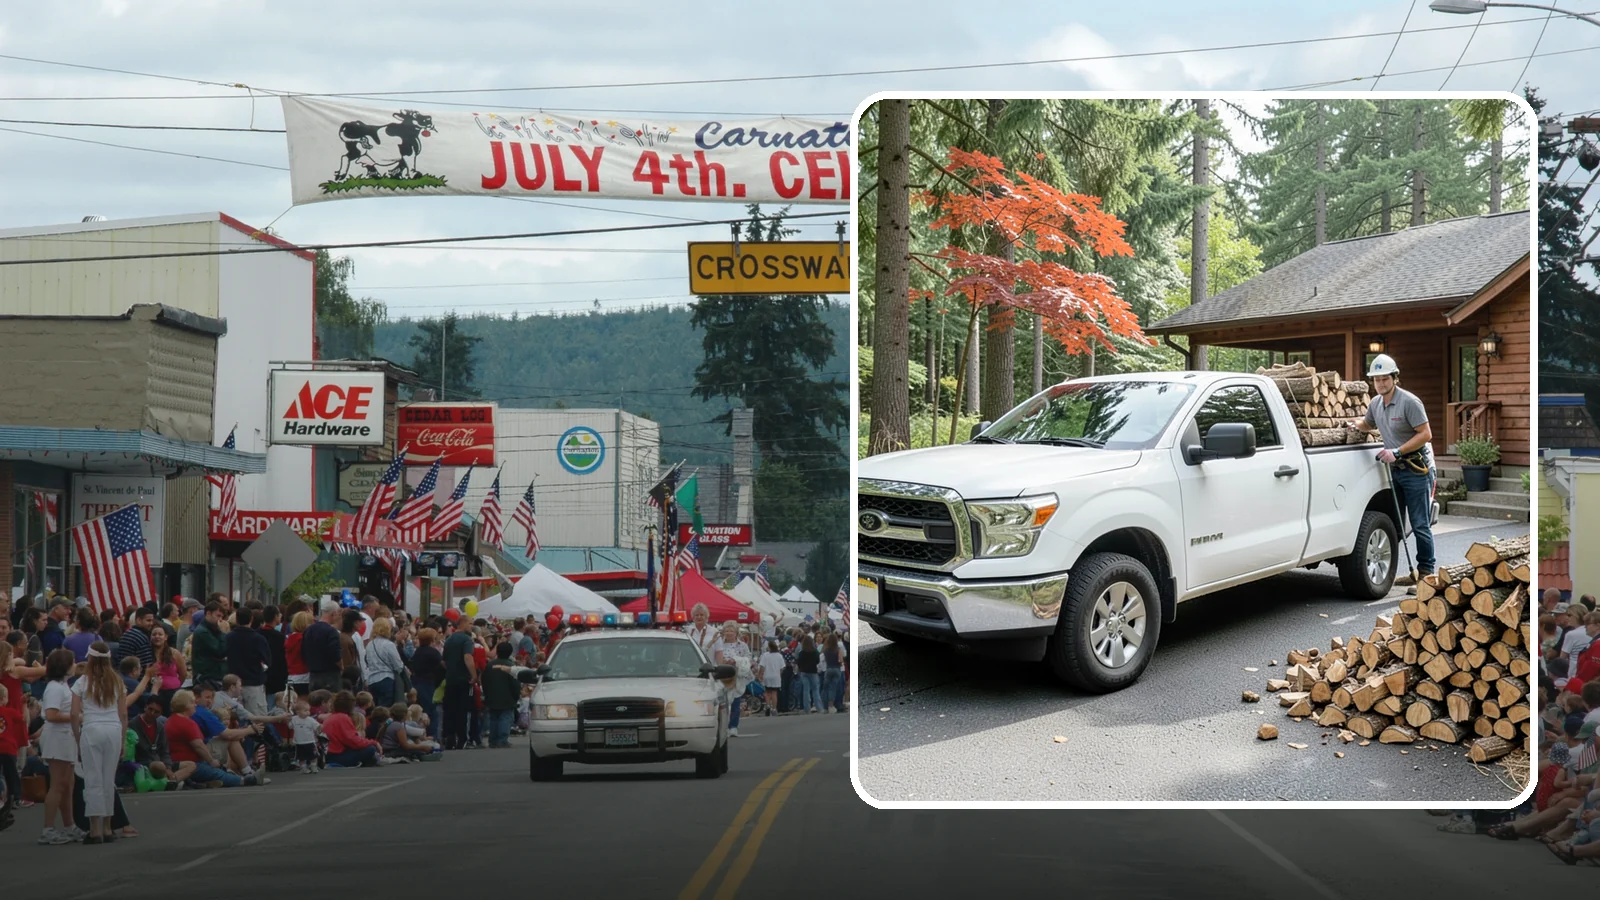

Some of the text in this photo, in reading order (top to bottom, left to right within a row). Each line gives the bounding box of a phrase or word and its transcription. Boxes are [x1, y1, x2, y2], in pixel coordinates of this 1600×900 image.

[481, 141, 605, 193] JULY
[632, 149, 746, 198] 4th.
[696, 254, 850, 280] CROSSWA
[283, 380, 373, 420] ACE
[405, 409, 485, 422] CEDAR LOG
[283, 421, 370, 436] Hardware
[416, 428, 477, 447] Coca-Cola
[96, 485, 124, 495] Vincent
[126, 487, 135, 495] de
[137, 486, 155, 496] Paul
[212, 515, 330, 535] HARDARE
[687, 526, 741, 536] CRNATION
[699, 535, 730, 543] GLASS
